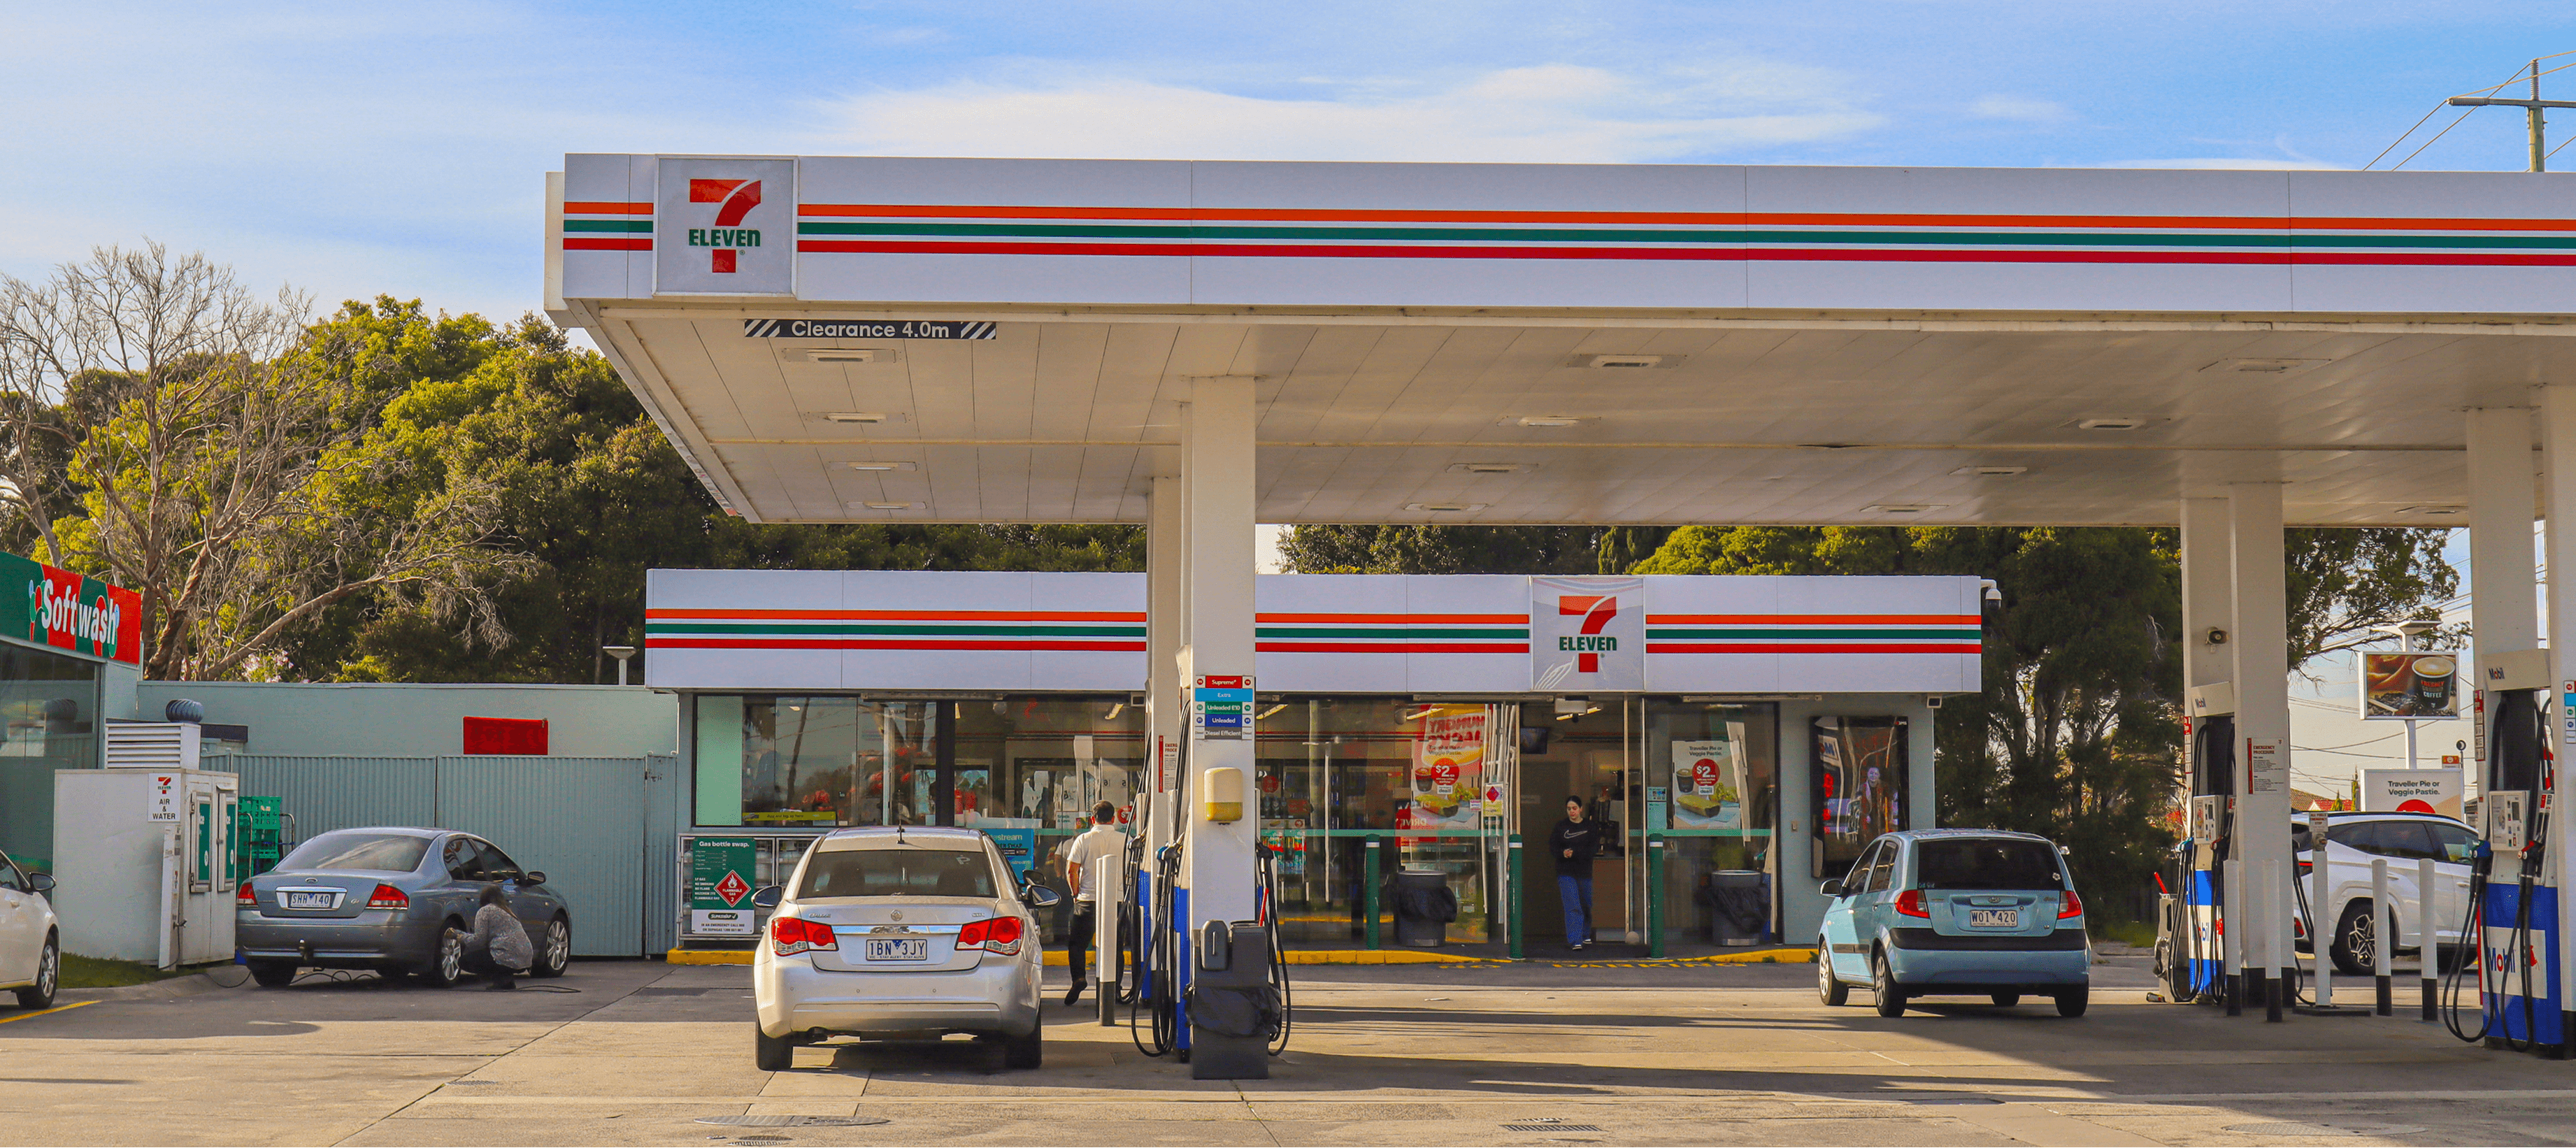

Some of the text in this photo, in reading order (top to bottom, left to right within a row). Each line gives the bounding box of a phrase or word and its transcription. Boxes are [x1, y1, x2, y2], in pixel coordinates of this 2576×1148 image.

[689, 178, 761, 273] 7
[791, 320, 949, 338] Clearance 4.0m
[1559, 596, 1617, 673] 7
[2488, 667, 2505, 680] Mobil
[157, 777, 171, 794] 7
[292, 894, 329, 904] SHH 140
[1998, 912, 2015, 922] 420
[870, 942, 925, 956] 1BN 3JY
